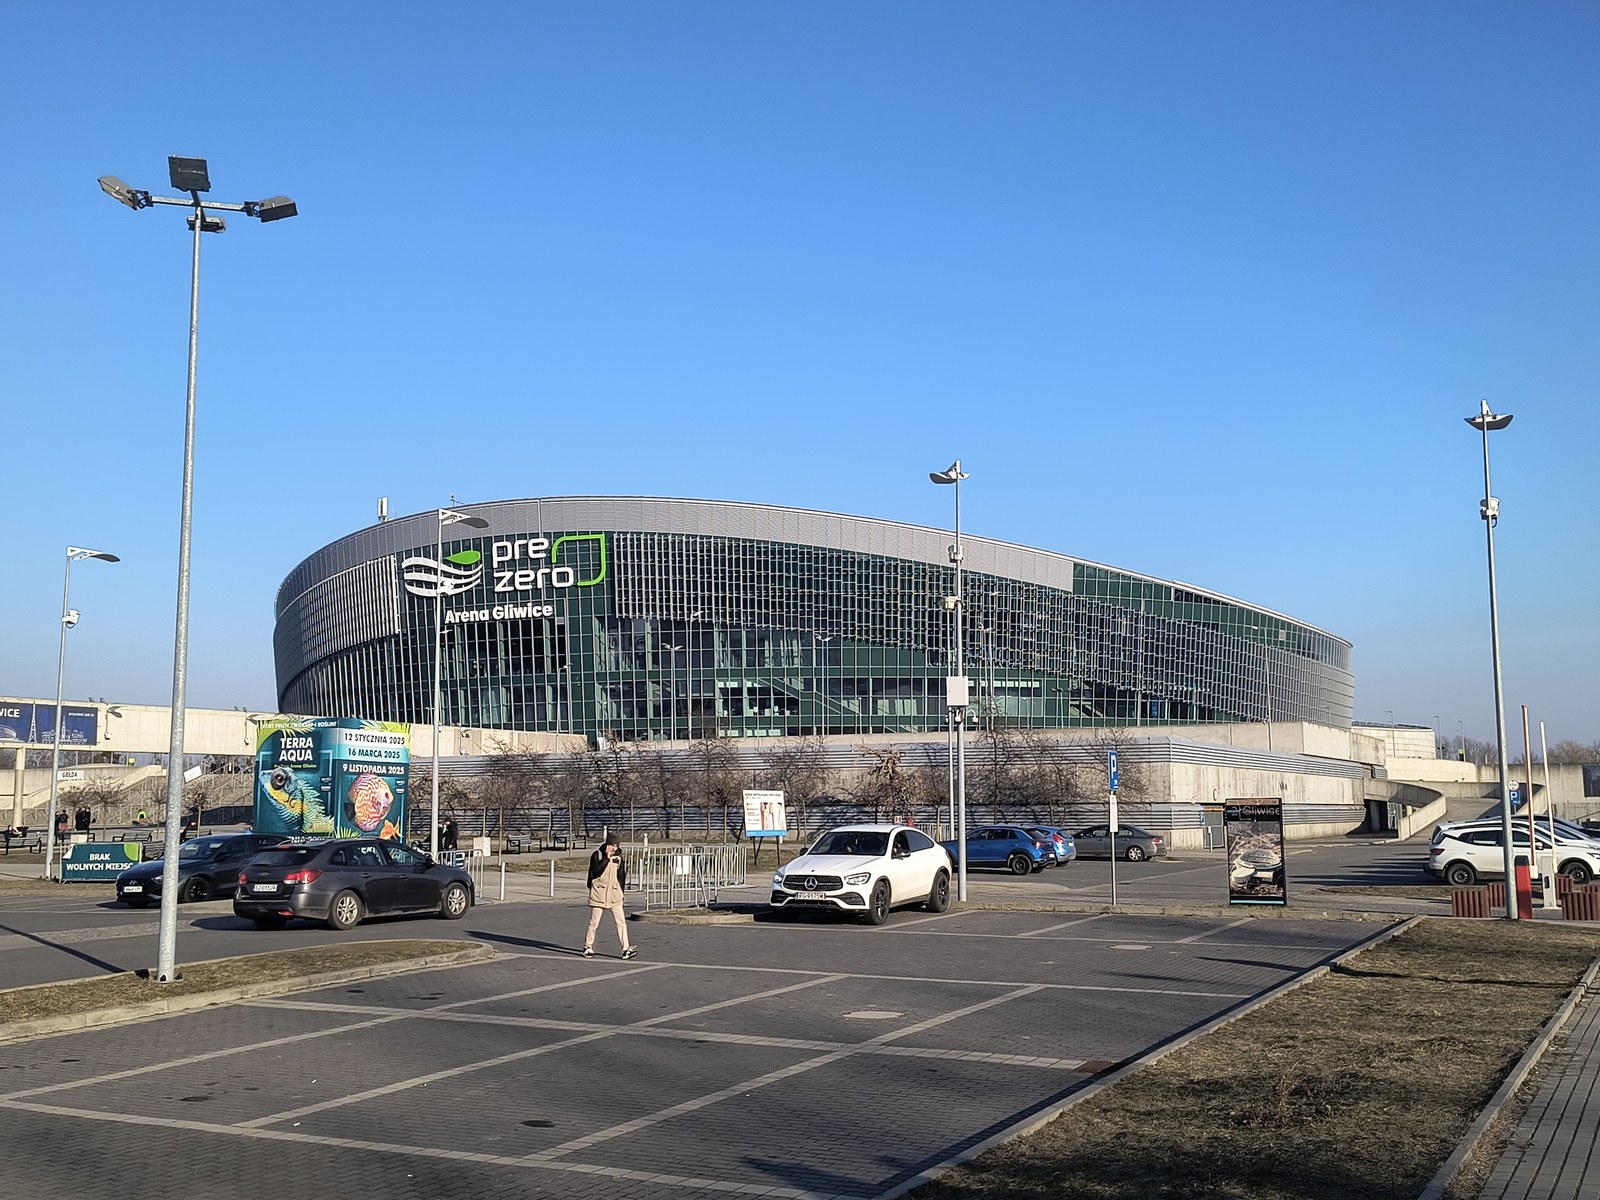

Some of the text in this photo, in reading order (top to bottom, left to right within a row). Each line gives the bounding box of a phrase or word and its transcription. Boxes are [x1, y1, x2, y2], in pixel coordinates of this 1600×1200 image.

[493, 538, 549, 568] pre
[493, 567, 574, 592] zero
[445, 603, 553, 624] Arena Gliwice
[280, 737, 314, 749] TERRA
[344, 732, 405, 745] 12 STYCZNIA 2025
[279, 749, 314, 762] AQUA
[348, 748, 401, 759] 16 MARCA 2025
[342, 763, 405, 775] 9 LISTOPADA 2025
[89, 853, 111, 861] BRAK
[66, 863, 104, 871] WOLNYCH
